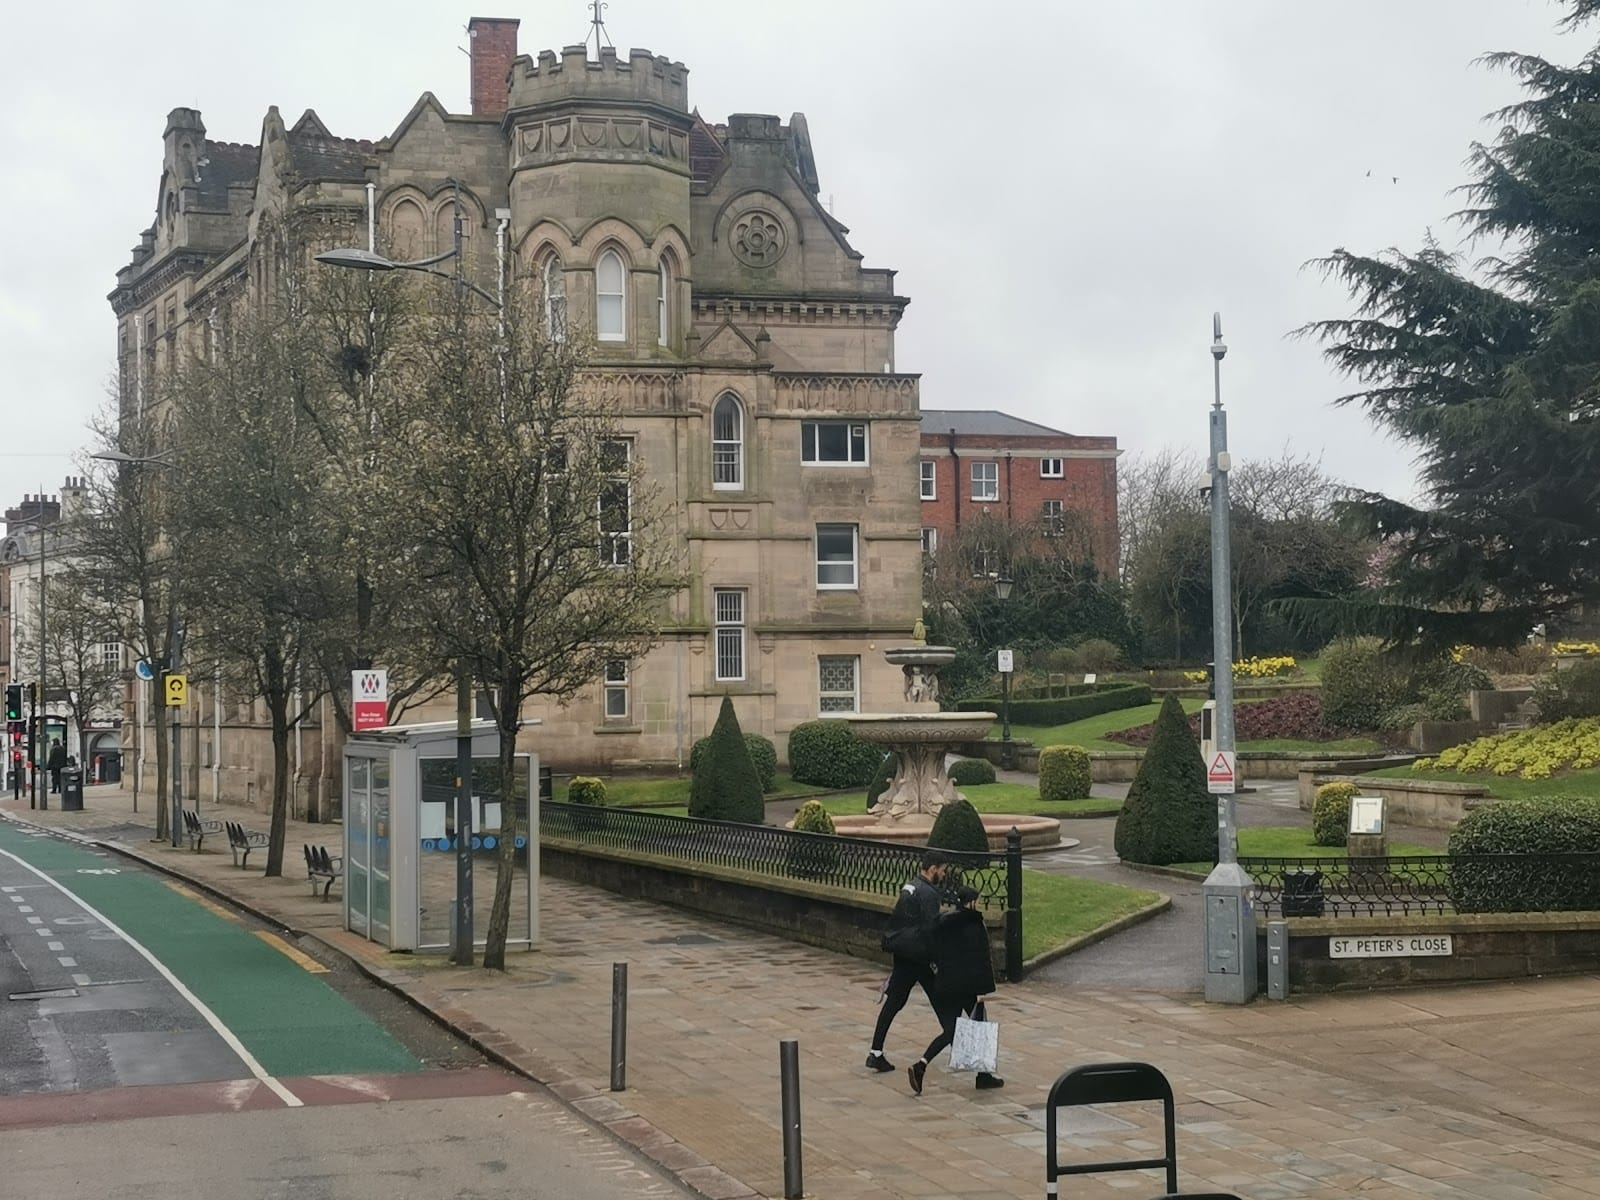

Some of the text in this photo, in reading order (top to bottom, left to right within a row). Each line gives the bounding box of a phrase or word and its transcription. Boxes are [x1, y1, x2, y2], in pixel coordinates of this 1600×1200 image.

[1335, 938, 1447, 952] ST. PETER'S CLOSE
